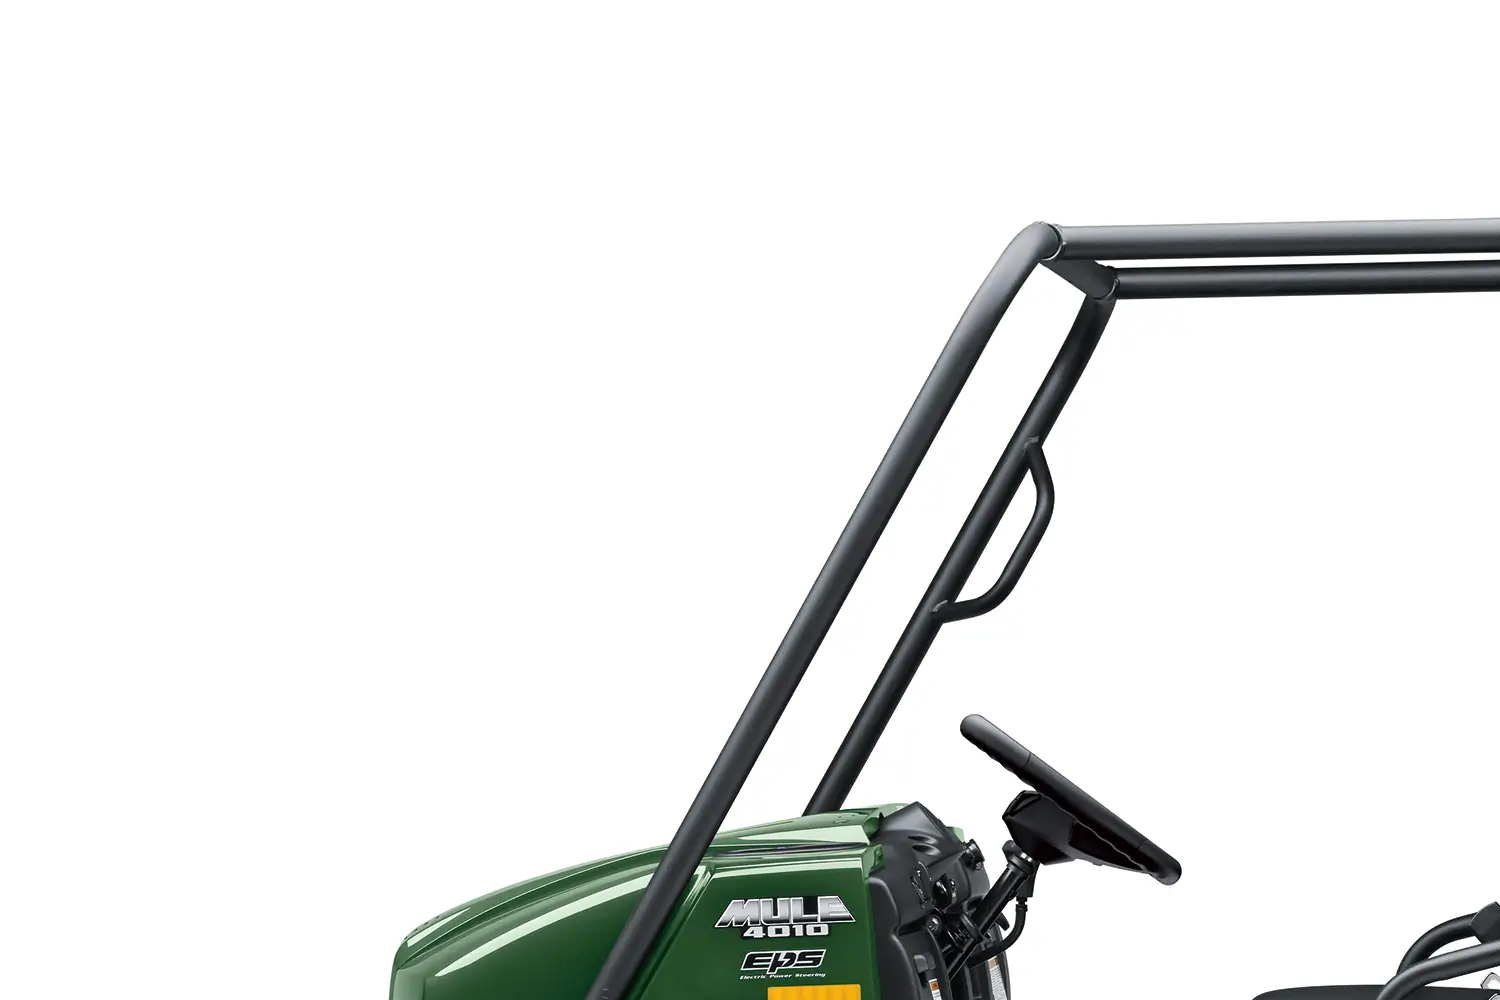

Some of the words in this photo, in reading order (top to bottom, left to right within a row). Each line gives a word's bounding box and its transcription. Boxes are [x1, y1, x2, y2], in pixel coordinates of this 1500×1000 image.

[714, 895, 856, 928] MULE
[743, 923, 829, 938] 4010
[740, 949, 826, 975] EPS
